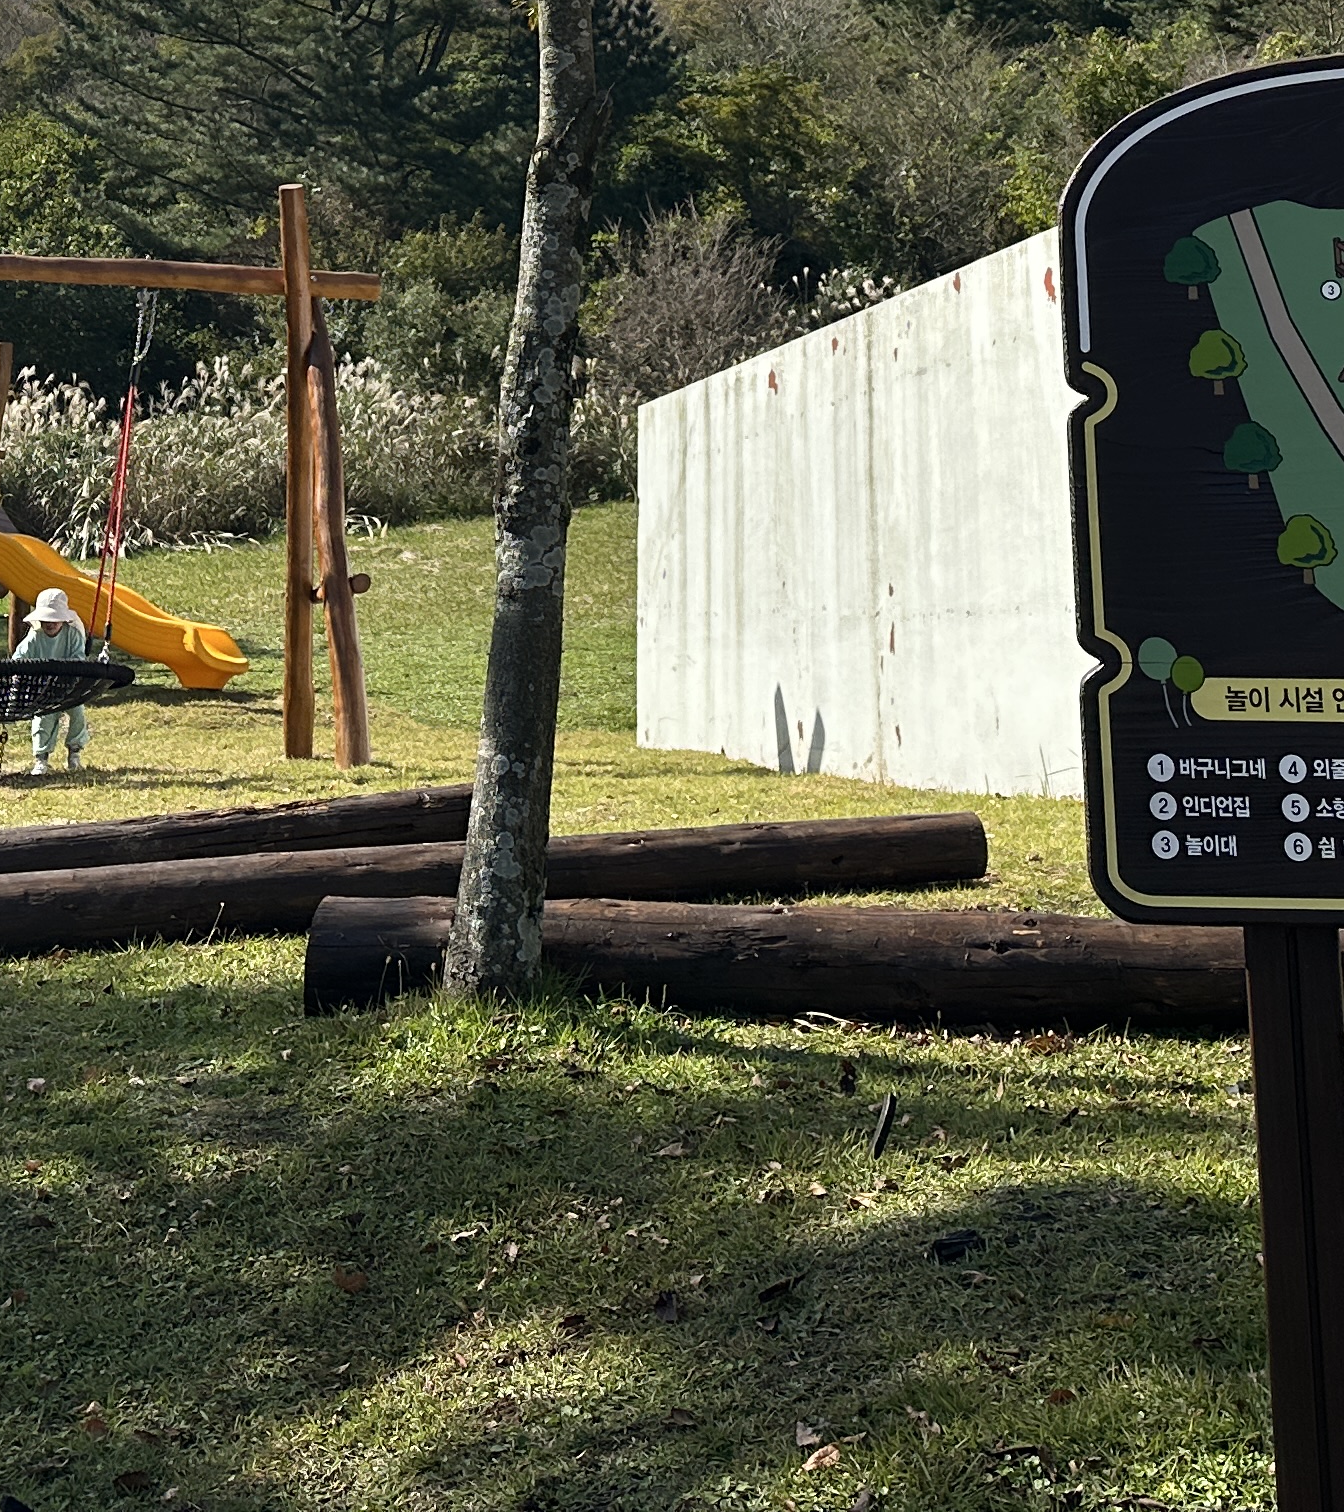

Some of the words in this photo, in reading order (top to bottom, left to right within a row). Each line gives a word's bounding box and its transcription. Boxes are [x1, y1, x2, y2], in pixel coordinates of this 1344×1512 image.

[1225, 686, 1270, 712] 놀이
[1279, 687, 1324, 713] 시설
[1157, 759, 1164, 776] 1
[1180, 758, 1265, 779] 바구니그네
[1287, 760, 1299, 777] 4
[1158, 797, 1170, 814] 2
[1183, 796, 1249, 817] 인디언집
[1290, 799, 1302, 816] 5
[1160, 836, 1171, 853] 3
[1186, 835, 1237, 856] 놀이대
[1293, 838, 1304, 856] 6
